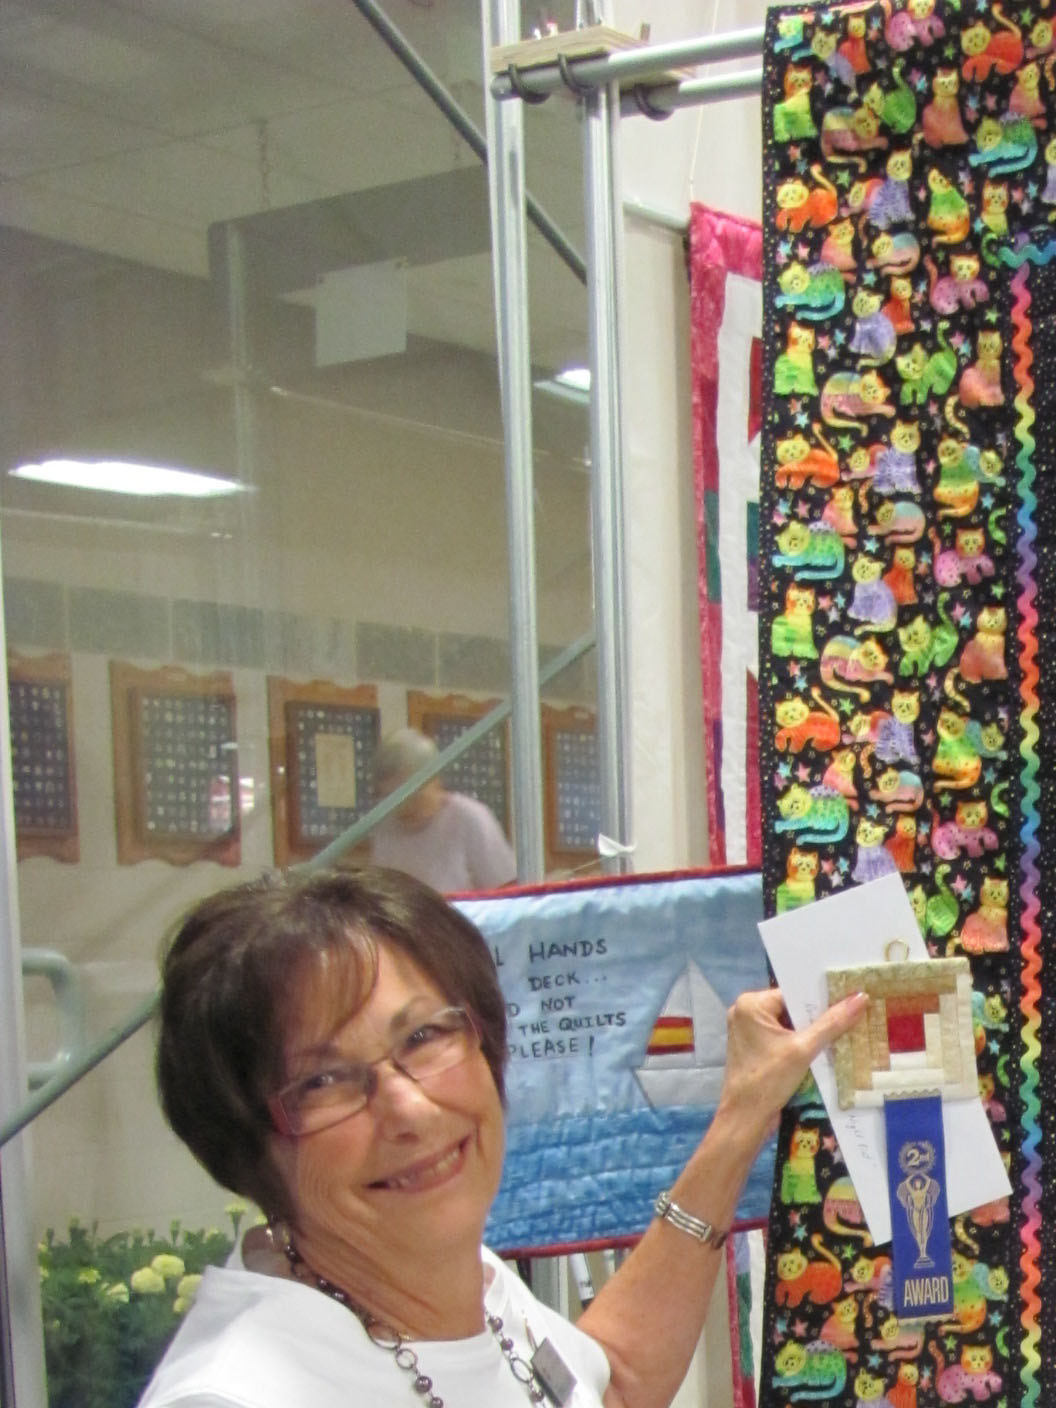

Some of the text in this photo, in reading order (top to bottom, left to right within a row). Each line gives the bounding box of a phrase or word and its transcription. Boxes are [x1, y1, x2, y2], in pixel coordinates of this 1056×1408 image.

[528, 938, 608, 963] HANDS
[541, 996, 576, 1012] NOT
[519, 1011, 627, 1036] THE QUILTS
[903, 1276, 950, 1308] AWARD
